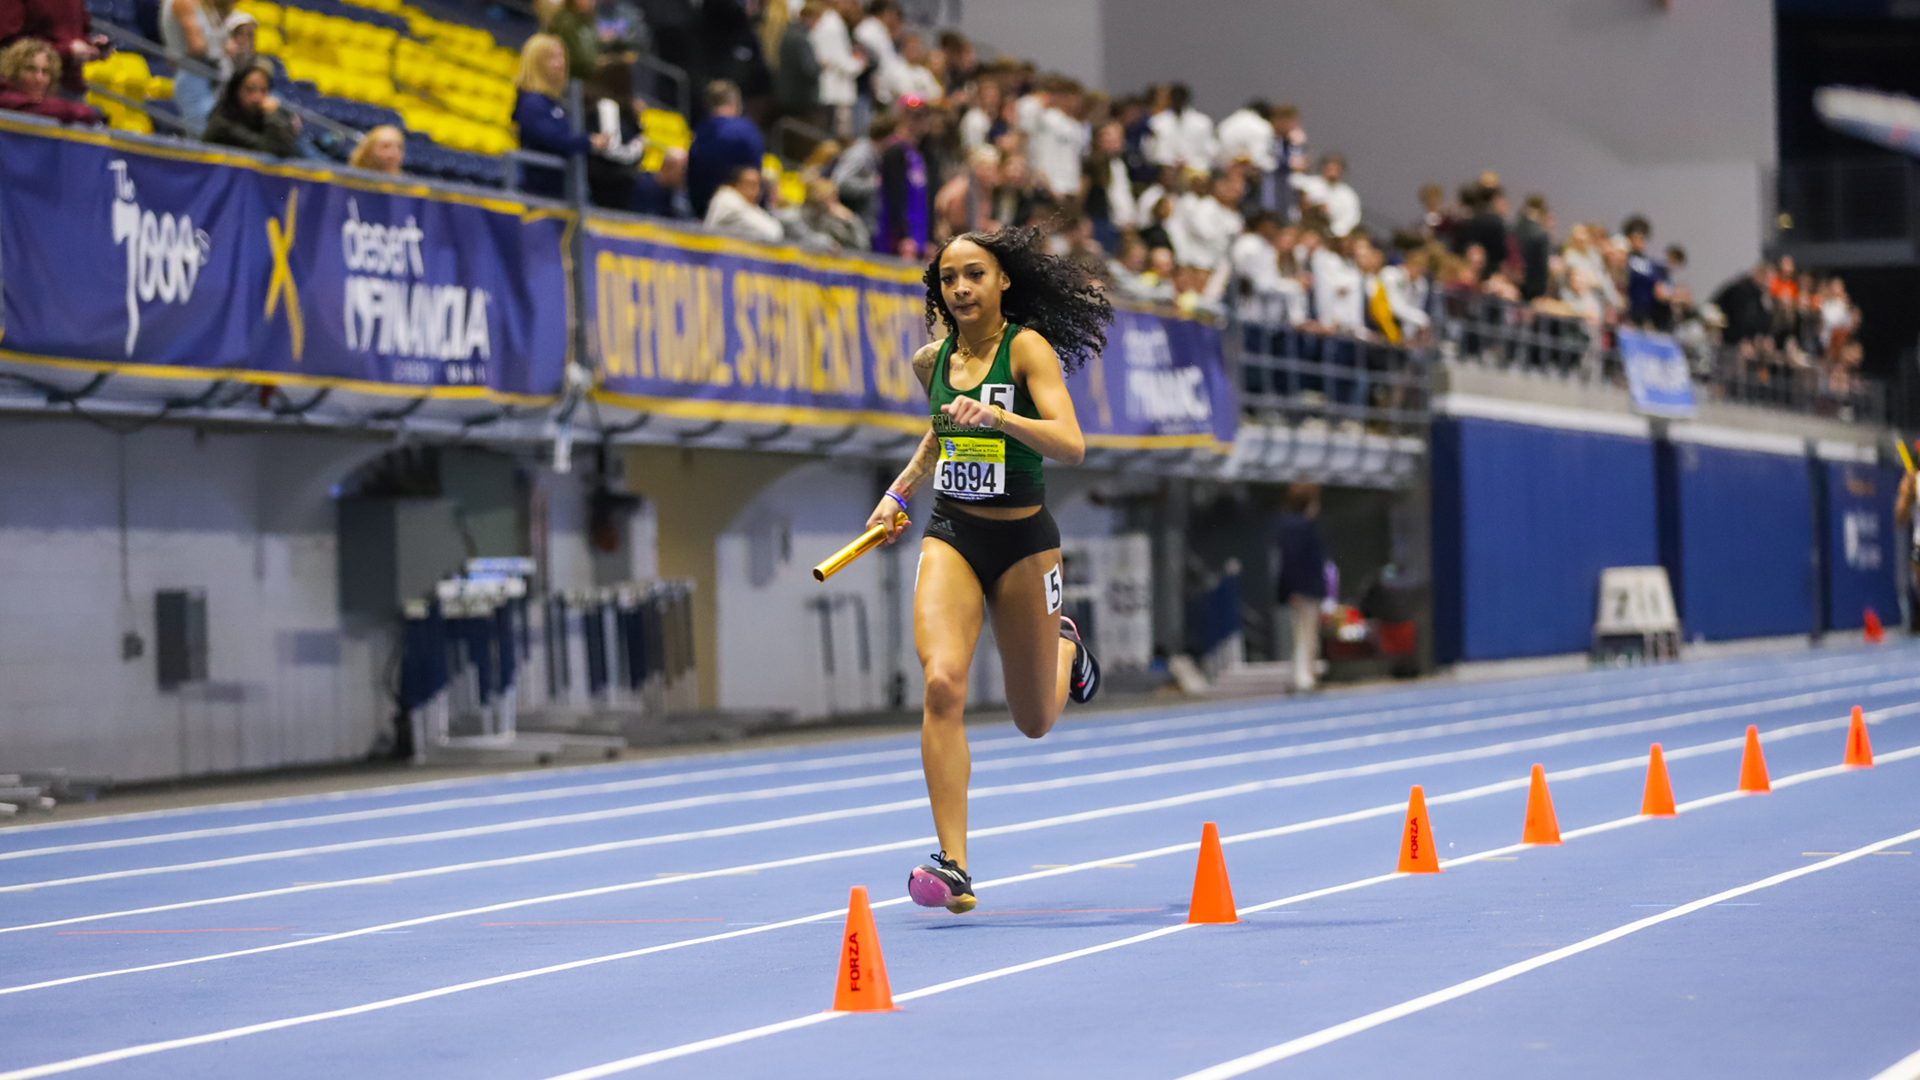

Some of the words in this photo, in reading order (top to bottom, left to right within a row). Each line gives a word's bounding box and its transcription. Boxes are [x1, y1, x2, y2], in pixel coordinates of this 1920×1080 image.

[989, 387, 1006, 410] 5
[941, 461, 996, 492] 5694
[933, 525, 956, 537] adidas
[1050, 571, 1060, 609] 5
[849, 931, 860, 992] FORZA
